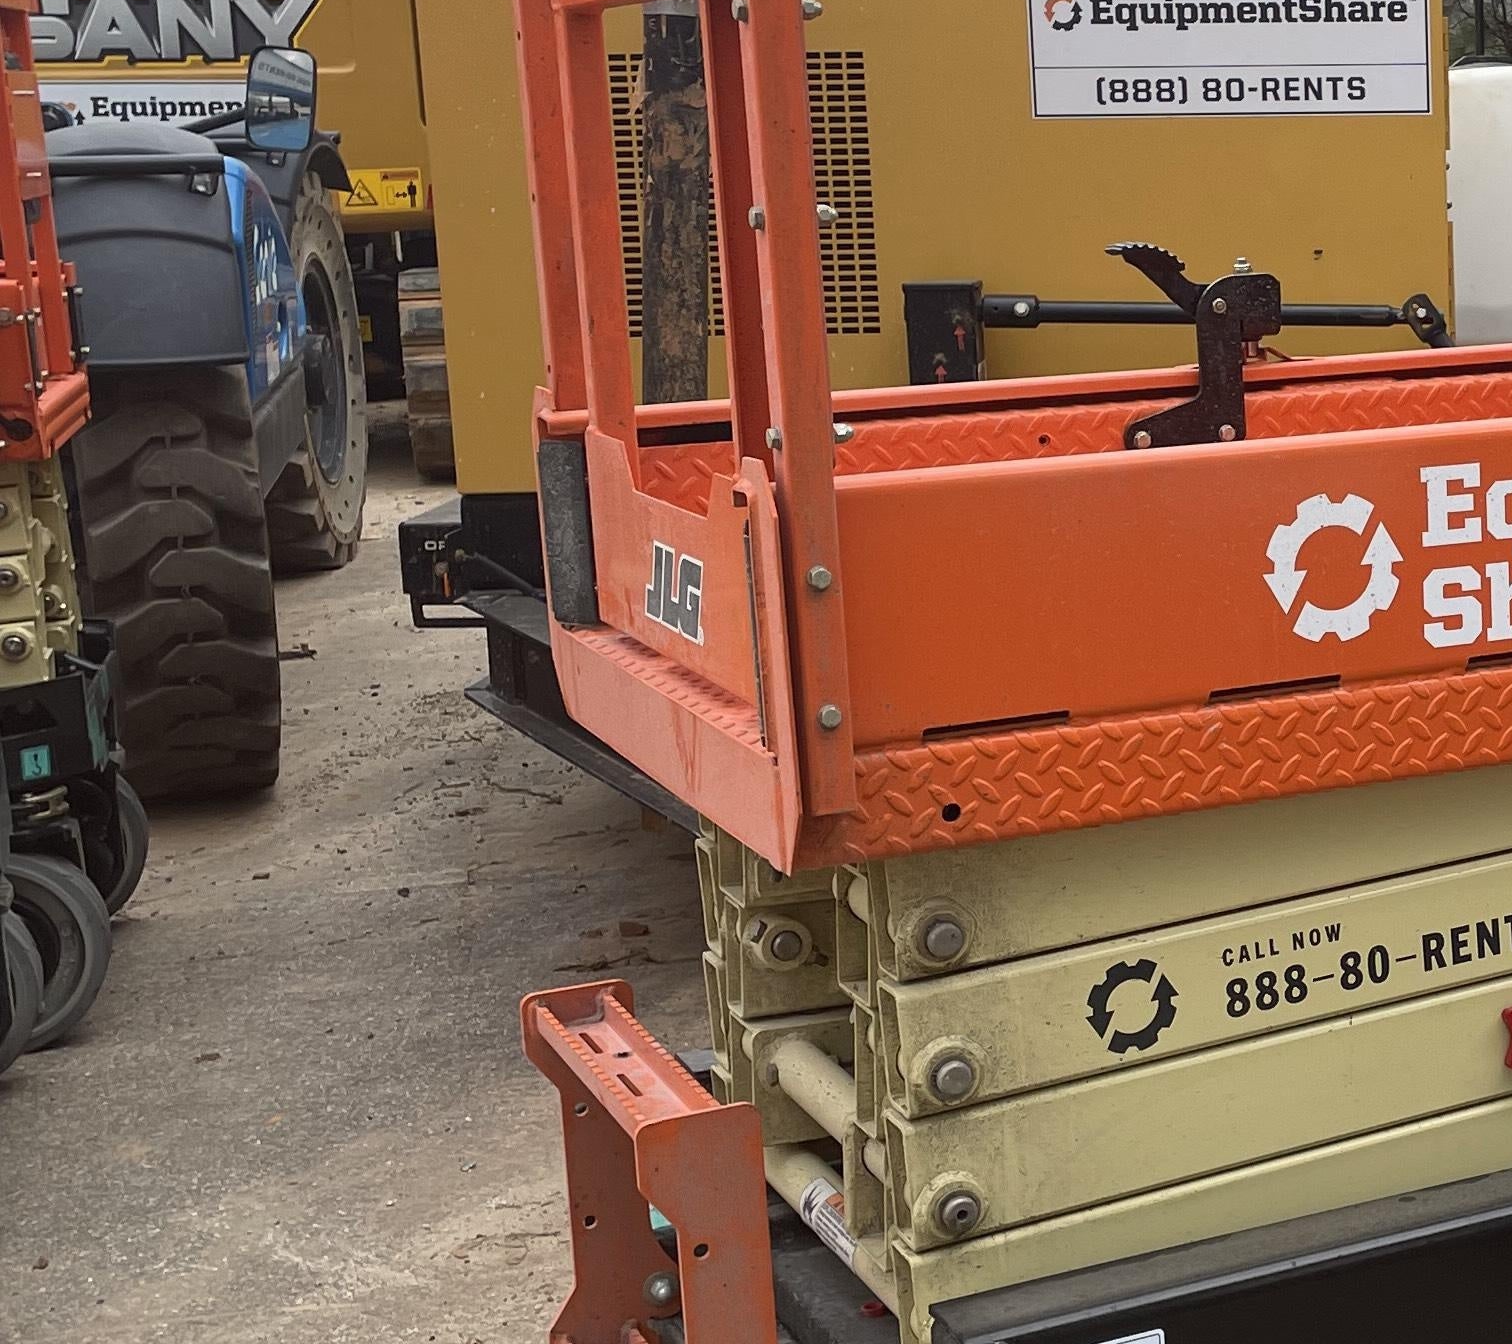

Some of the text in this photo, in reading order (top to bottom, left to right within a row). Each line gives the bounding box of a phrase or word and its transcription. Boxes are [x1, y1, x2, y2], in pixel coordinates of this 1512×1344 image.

[1096, 75, 1367, 105] (888) 80-RENTS
[644, 539, 705, 646] JLG
[1221, 922, 1342, 968] CALL NOW
